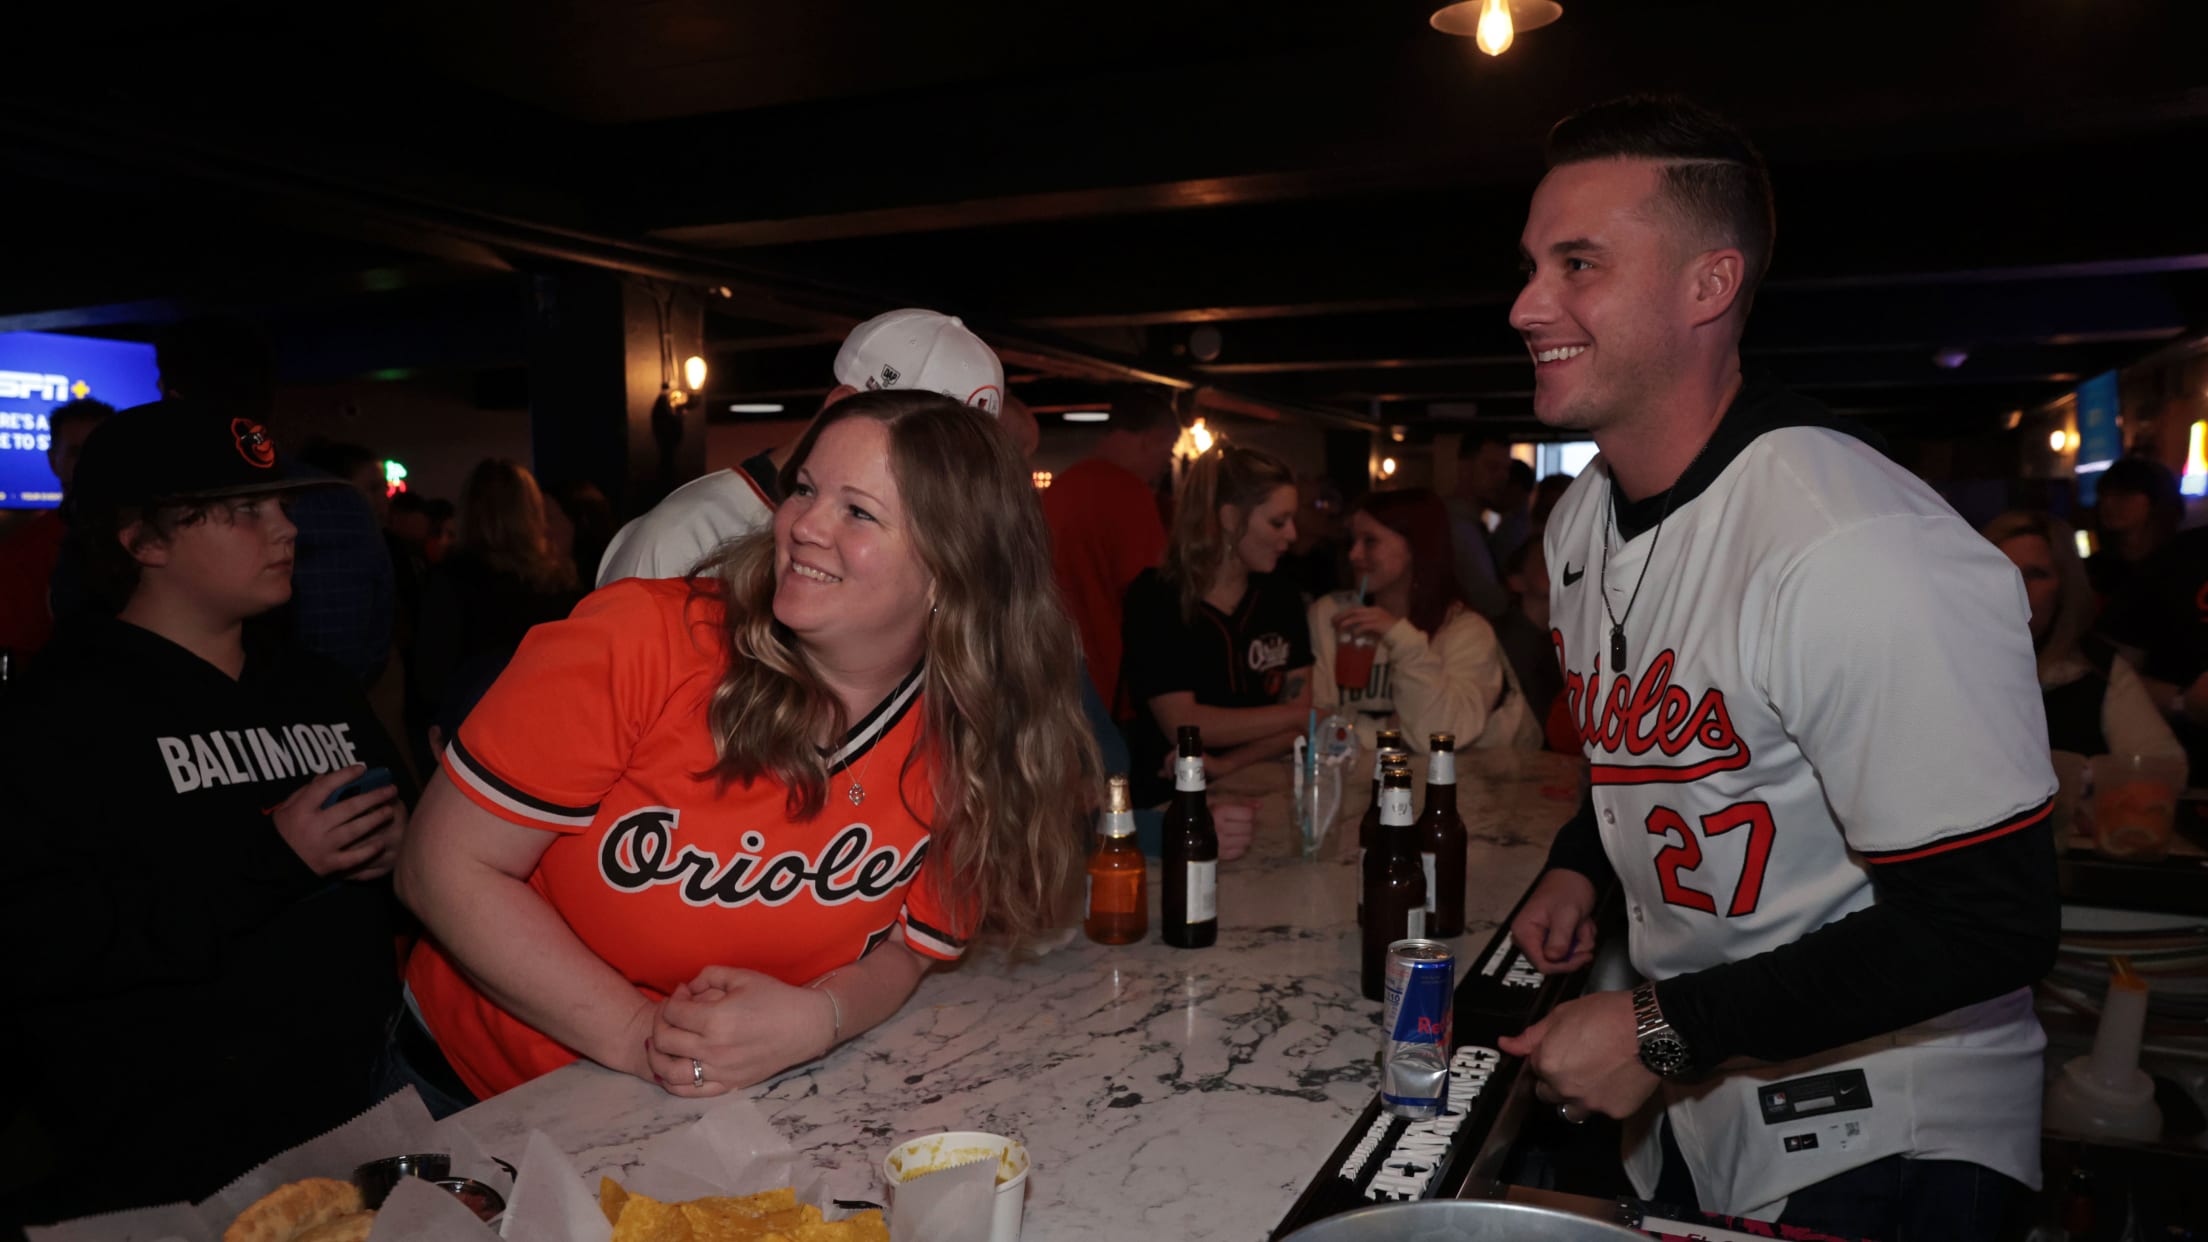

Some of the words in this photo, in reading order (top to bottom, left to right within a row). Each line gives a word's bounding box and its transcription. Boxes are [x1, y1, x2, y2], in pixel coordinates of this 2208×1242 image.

[14, 433, 35, 450] TO
[156, 722, 367, 794] BALTIMORE
[1646, 801, 1776, 917] 27
